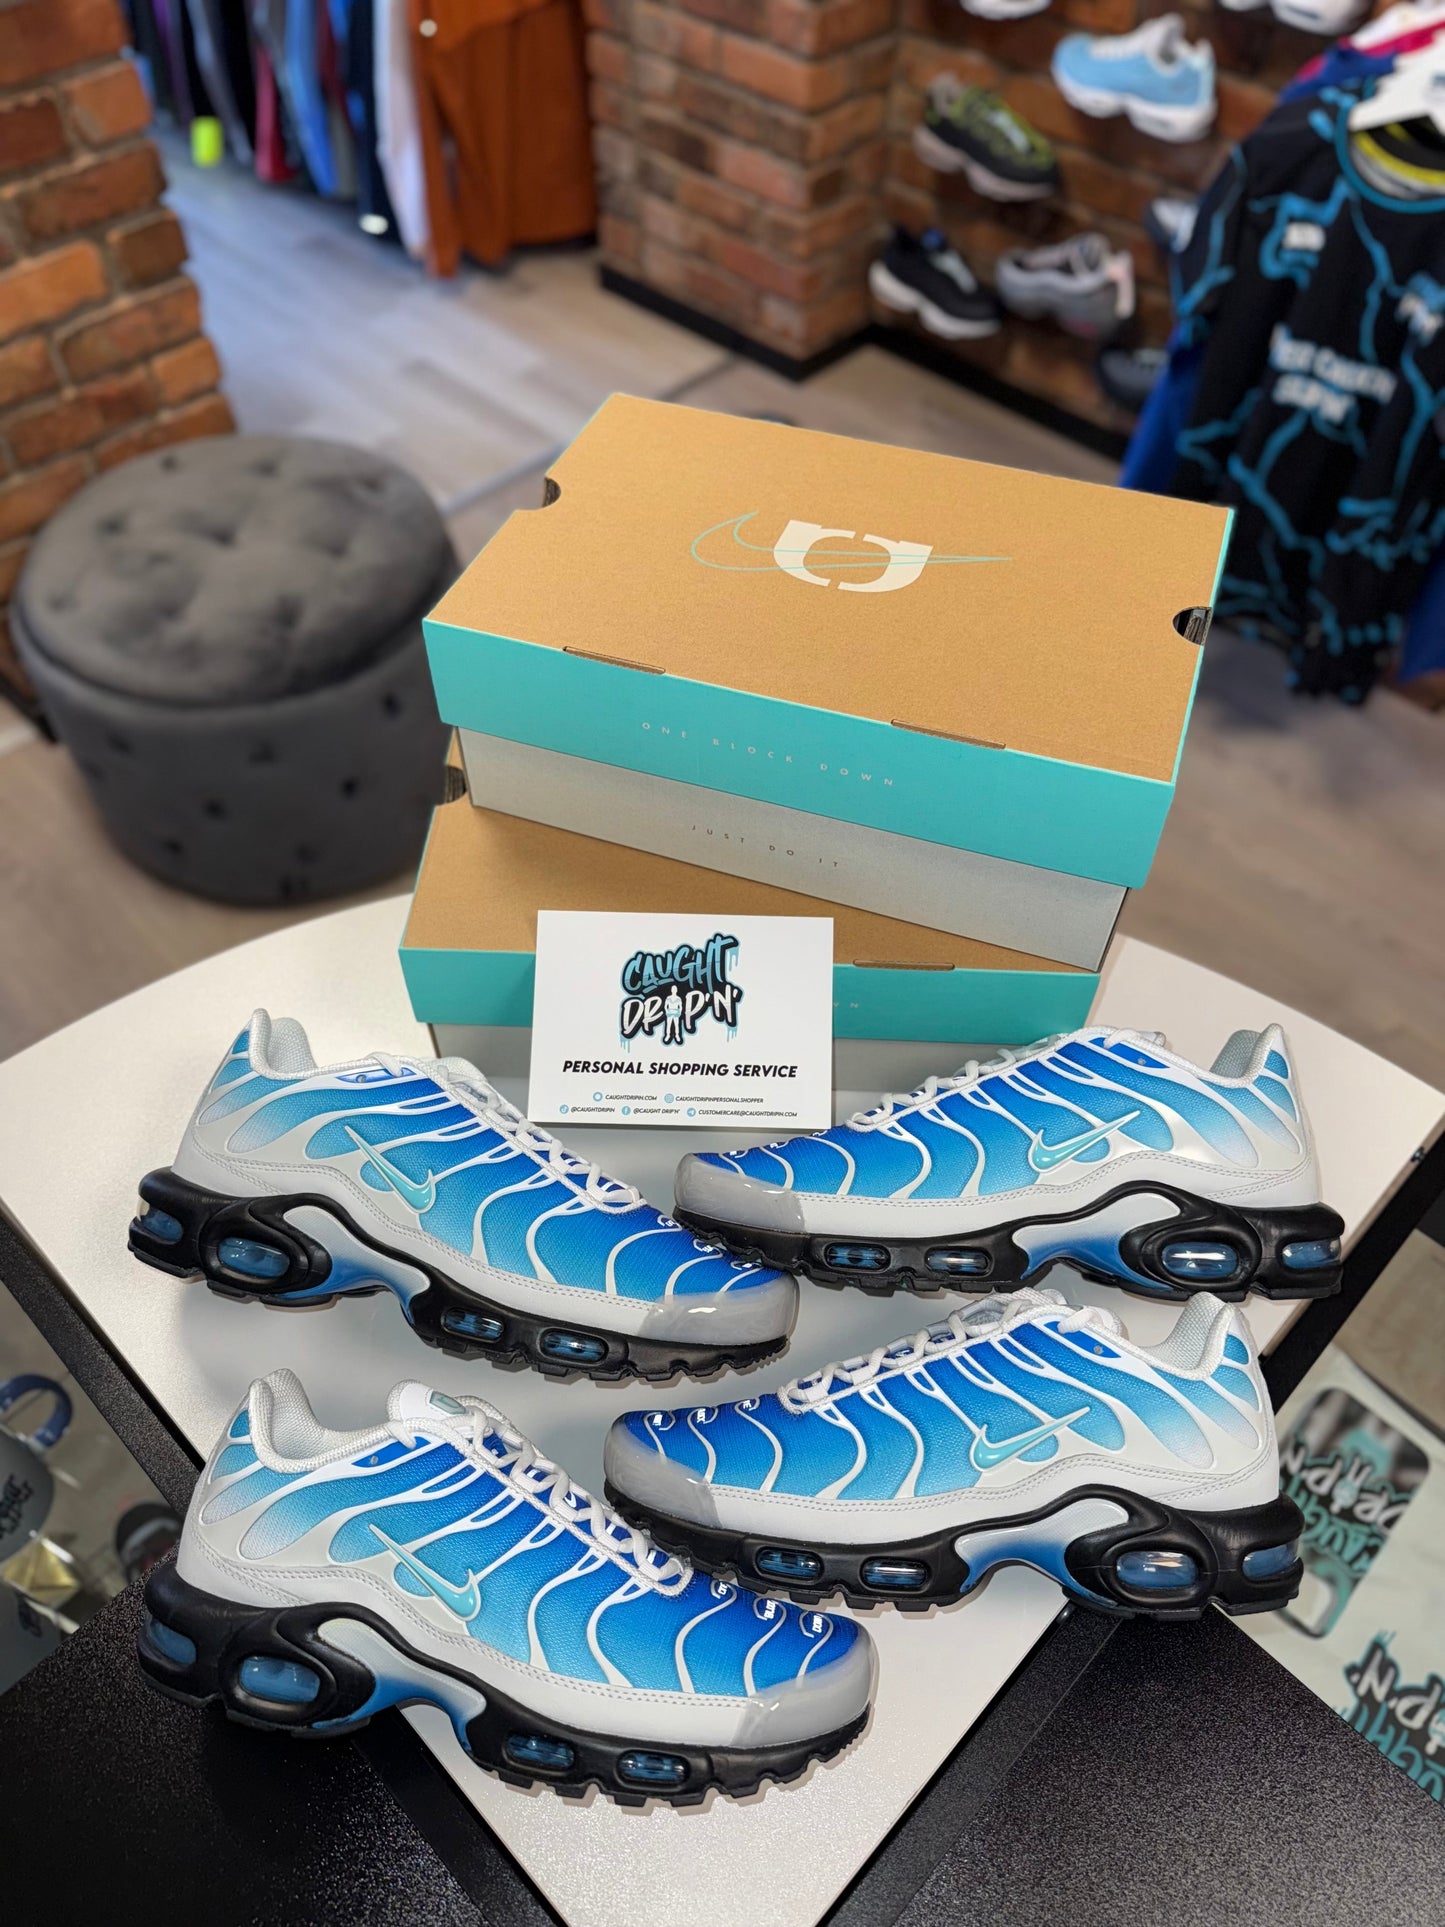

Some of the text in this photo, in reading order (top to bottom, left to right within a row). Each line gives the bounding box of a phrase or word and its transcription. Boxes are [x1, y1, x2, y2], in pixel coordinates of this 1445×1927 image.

[641, 721, 894, 787] ONE BLOCK DOWN
[691, 824, 839, 868] JUST DO IT
[622, 933, 739, 994] CAUGHT
[562, 1060, 798, 1078] PERSONAL SHOPPING SERVICE
[675, 1095, 764, 1104] CAUGHTDRIPINPERSONALSHOPPER
[698, 1109, 798, 1117] CUSTOMERCARE@CAUGHTDRIPIN.COM
